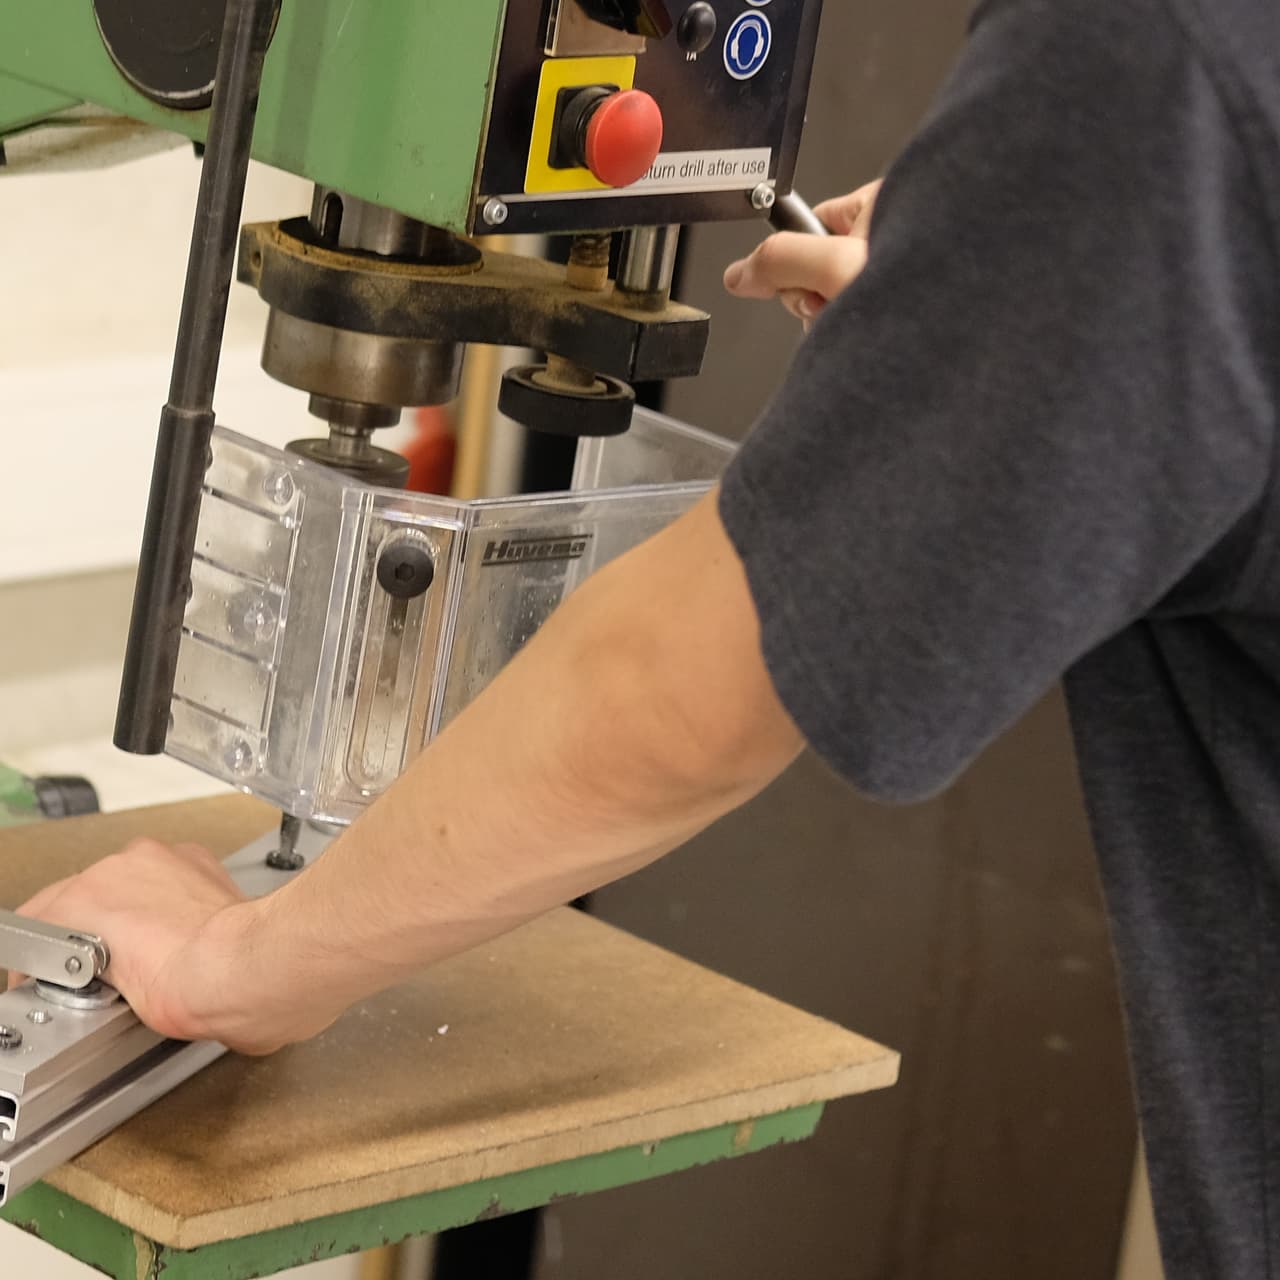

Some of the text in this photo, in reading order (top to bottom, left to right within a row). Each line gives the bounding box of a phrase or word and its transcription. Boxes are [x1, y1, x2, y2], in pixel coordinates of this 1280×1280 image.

[641, 158, 766, 181] turn drill after use
[483, 539, 586, 561] Huvema
